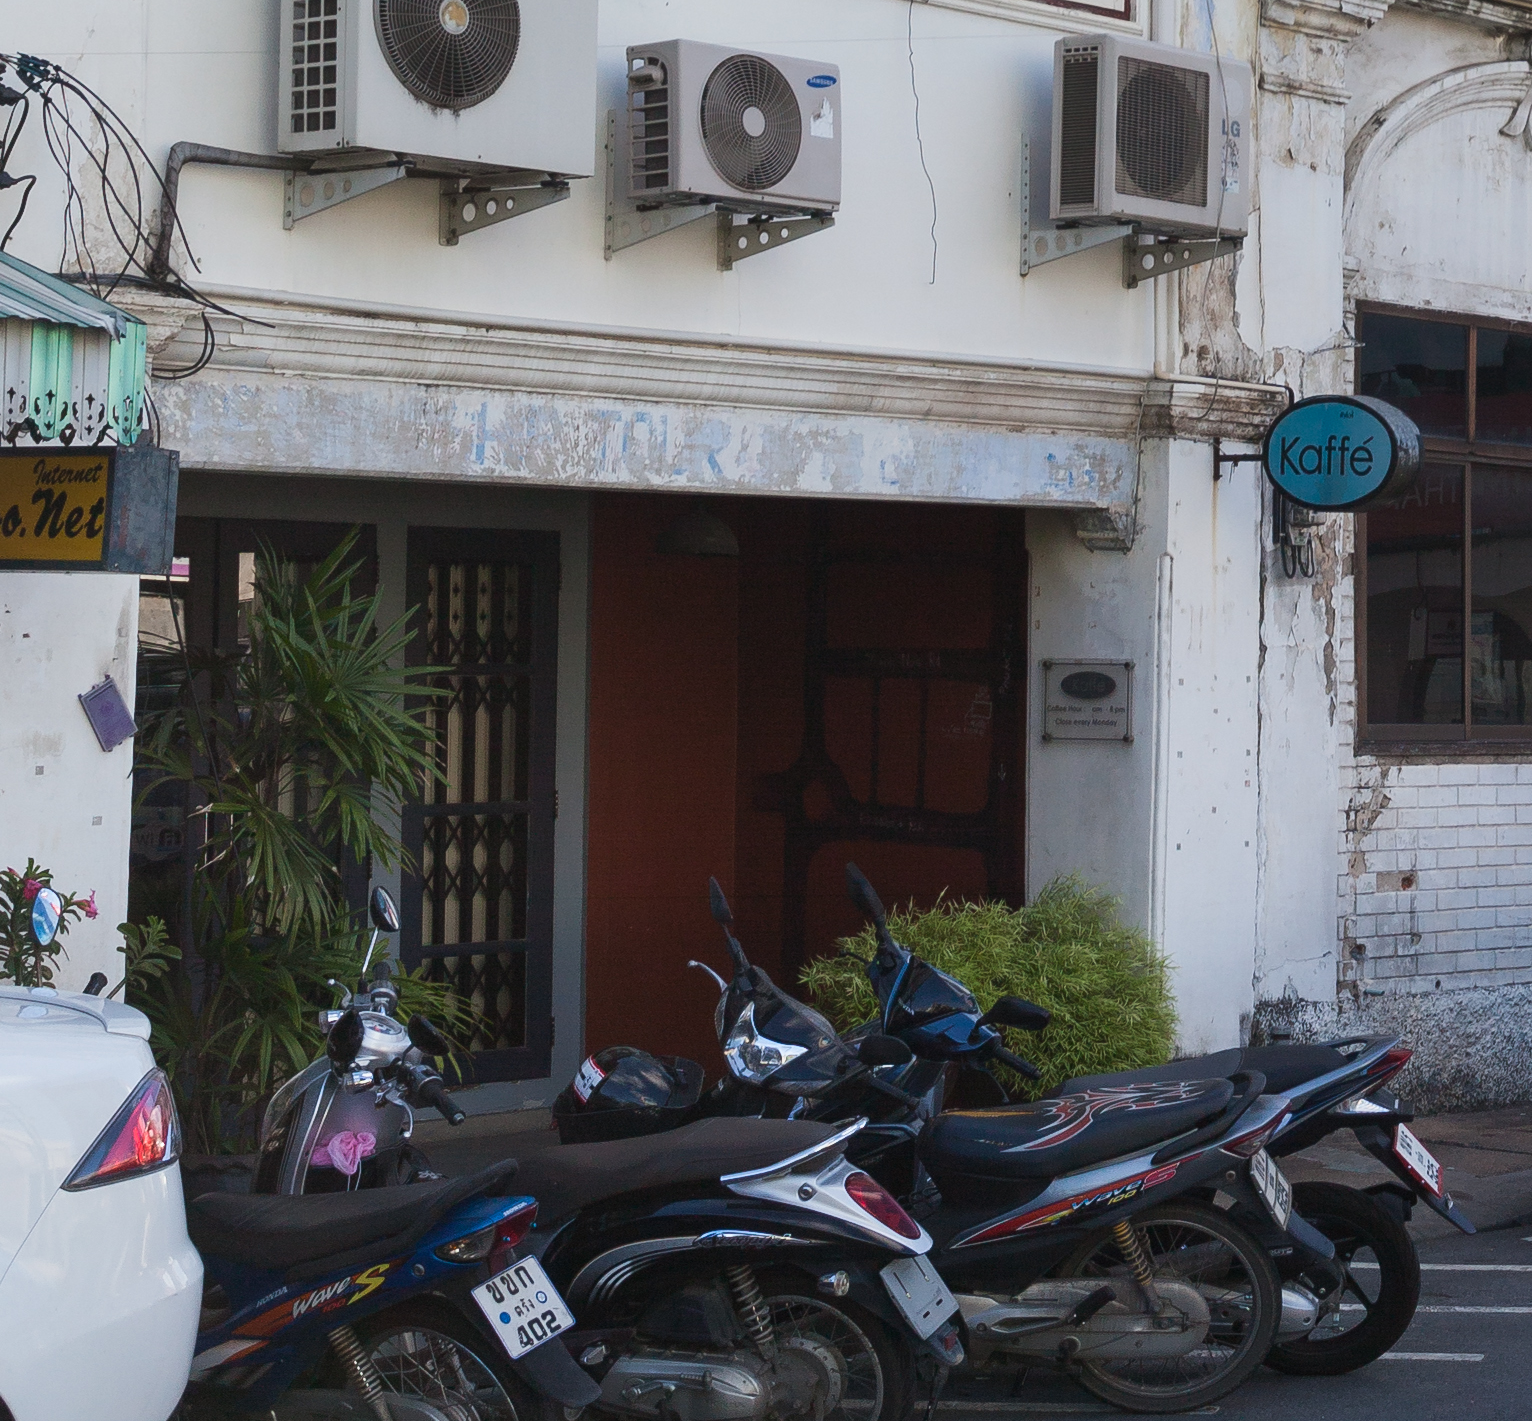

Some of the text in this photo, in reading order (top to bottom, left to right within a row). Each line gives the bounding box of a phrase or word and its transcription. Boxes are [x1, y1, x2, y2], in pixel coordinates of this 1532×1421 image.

[1221, 118, 1241, 138] LG
[1279, 434, 1374, 477] Kaffé
[33, 458, 104, 486] Internet
[0, 487, 106, 539] o.Net
[1107, 1189, 1138, 1206] 100
[256, 1285, 288, 1308] HONDA
[347, 1262, 390, 1306] S
[514, 1298, 536, 1317] ตรัง
[517, 1309, 562, 1349] 402
